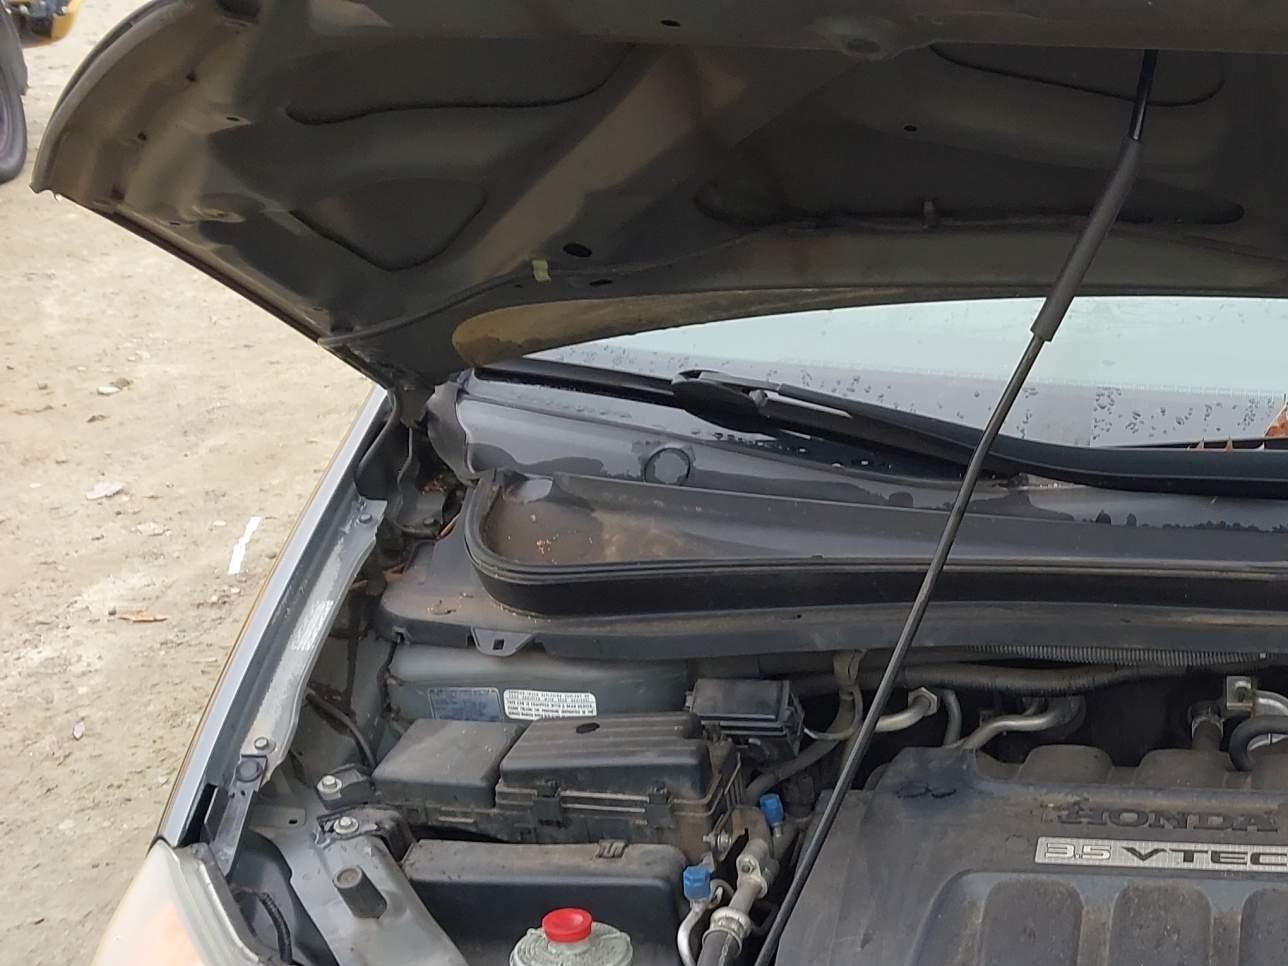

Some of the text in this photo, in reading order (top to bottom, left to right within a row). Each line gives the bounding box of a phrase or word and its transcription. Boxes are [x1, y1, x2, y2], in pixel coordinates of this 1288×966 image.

[1056, 803, 1279, 832] HONDA
[1045, 842, 1288, 867] 3.5 VTEC
